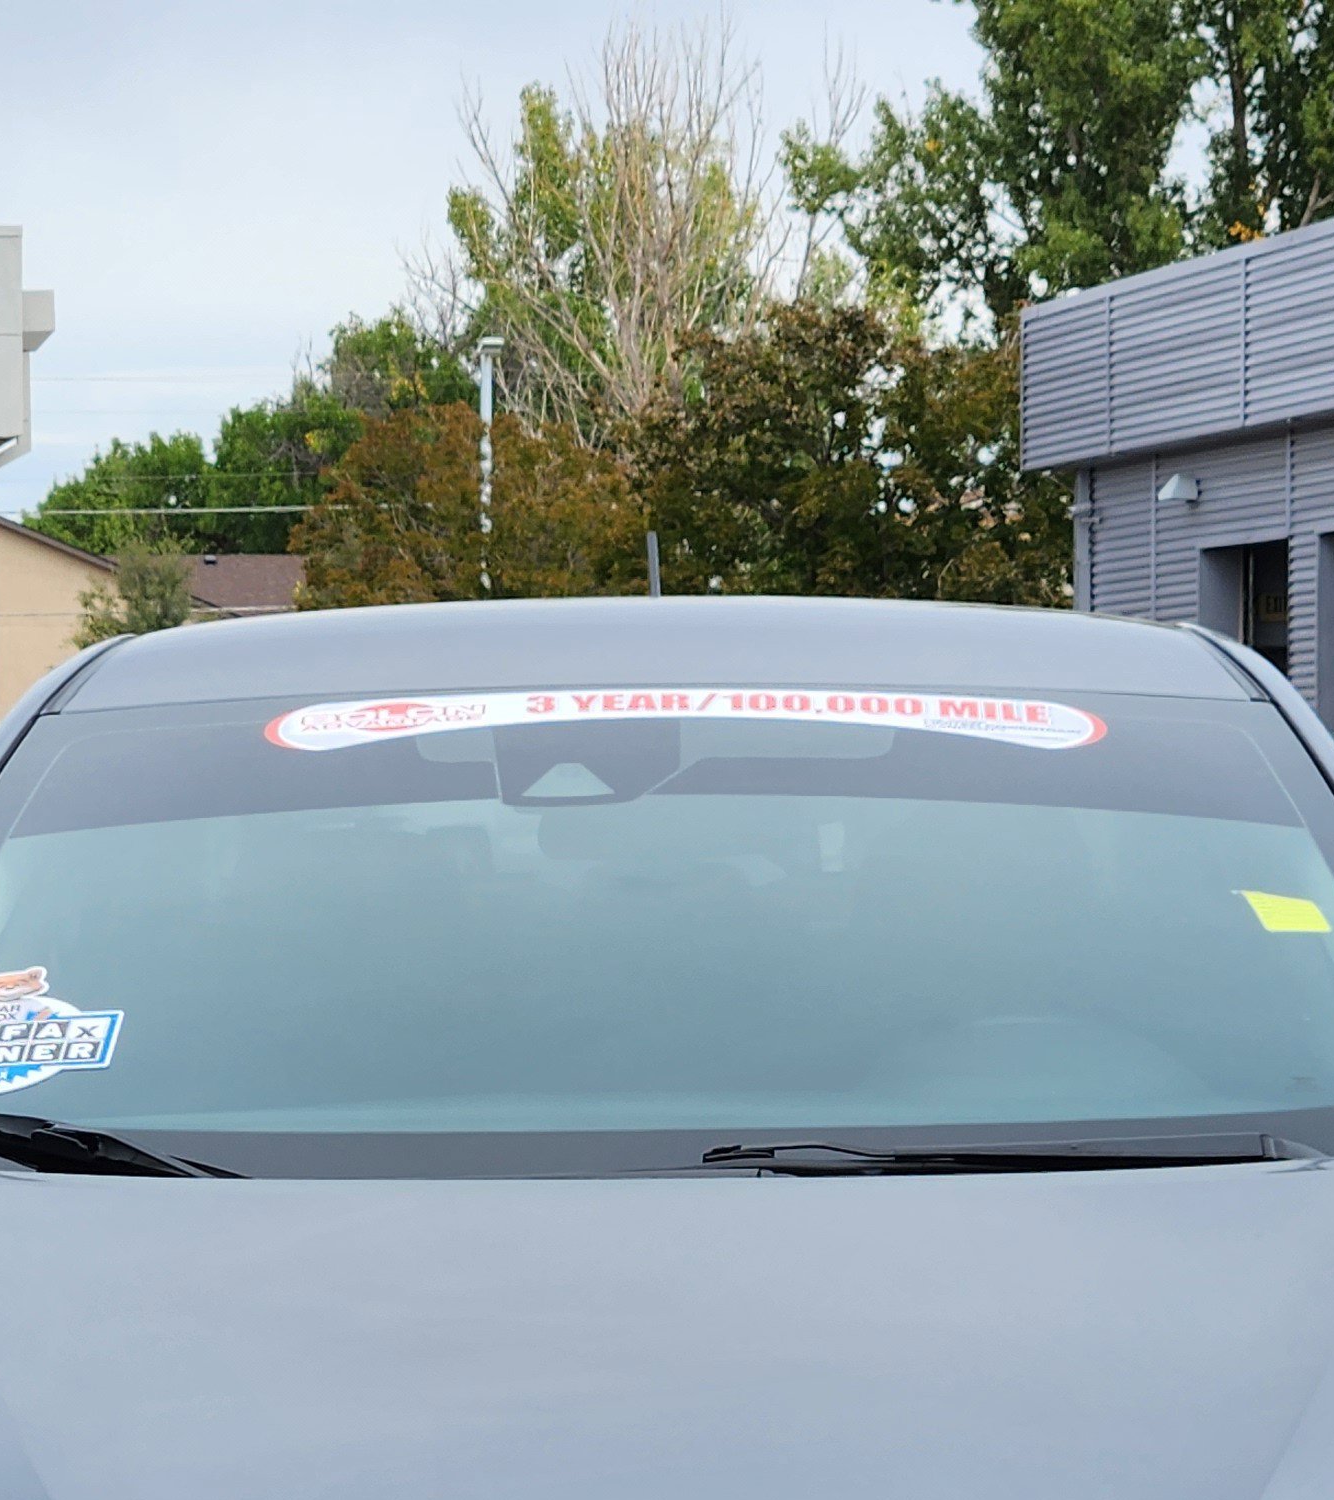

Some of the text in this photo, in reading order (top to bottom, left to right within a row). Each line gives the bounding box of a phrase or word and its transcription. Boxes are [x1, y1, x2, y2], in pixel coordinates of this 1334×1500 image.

[527, 693, 1051, 724] 3 YEAR/100,000 MILE
